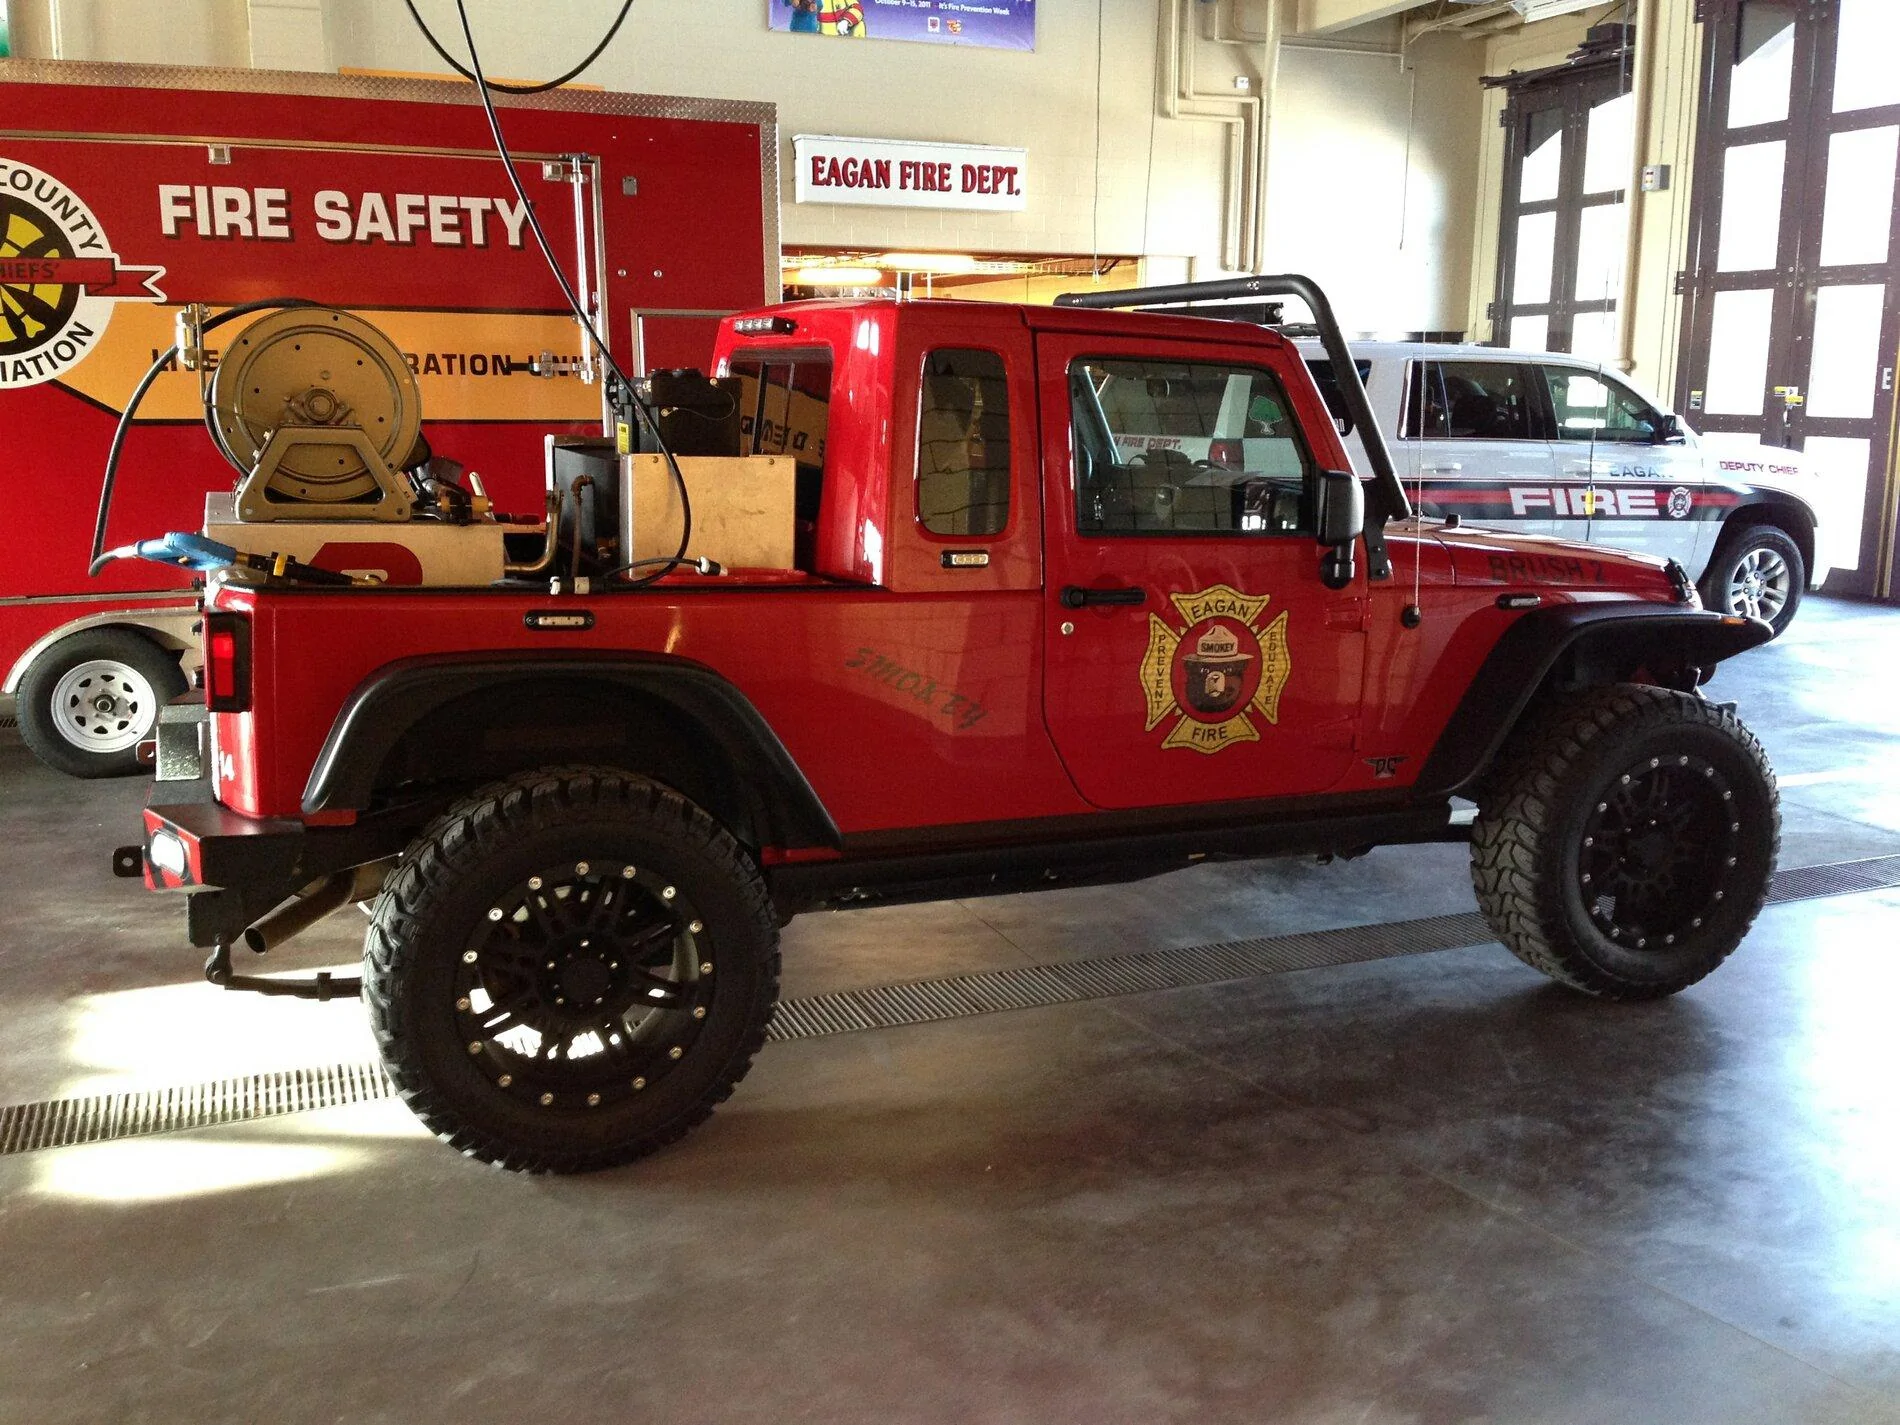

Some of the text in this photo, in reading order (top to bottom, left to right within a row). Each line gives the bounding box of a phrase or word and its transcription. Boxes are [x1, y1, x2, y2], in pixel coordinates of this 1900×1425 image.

[948, 3, 960, 11] Fire
[960, 4, 992, 13] Prevention
[993, 6, 1010, 15] Week
[811, 156, 1021, 196] EAGAN FIRE DEPT.
[159, 184, 531, 246] FIRE SAFETY
[1719, 460, 1765, 473] DEPUTY
[1508, 487, 1660, 516] FIRE
[1488, 555, 1583, 583] BRUSH
[1191, 599, 1250, 620] EAGAN
[1201, 642, 1235, 653] SMOKEY
[1154, 634, 1167, 710] PREVENT
[1264, 631, 1278, 706] EDUCATE
[1191, 726, 1229, 743] FIRE
